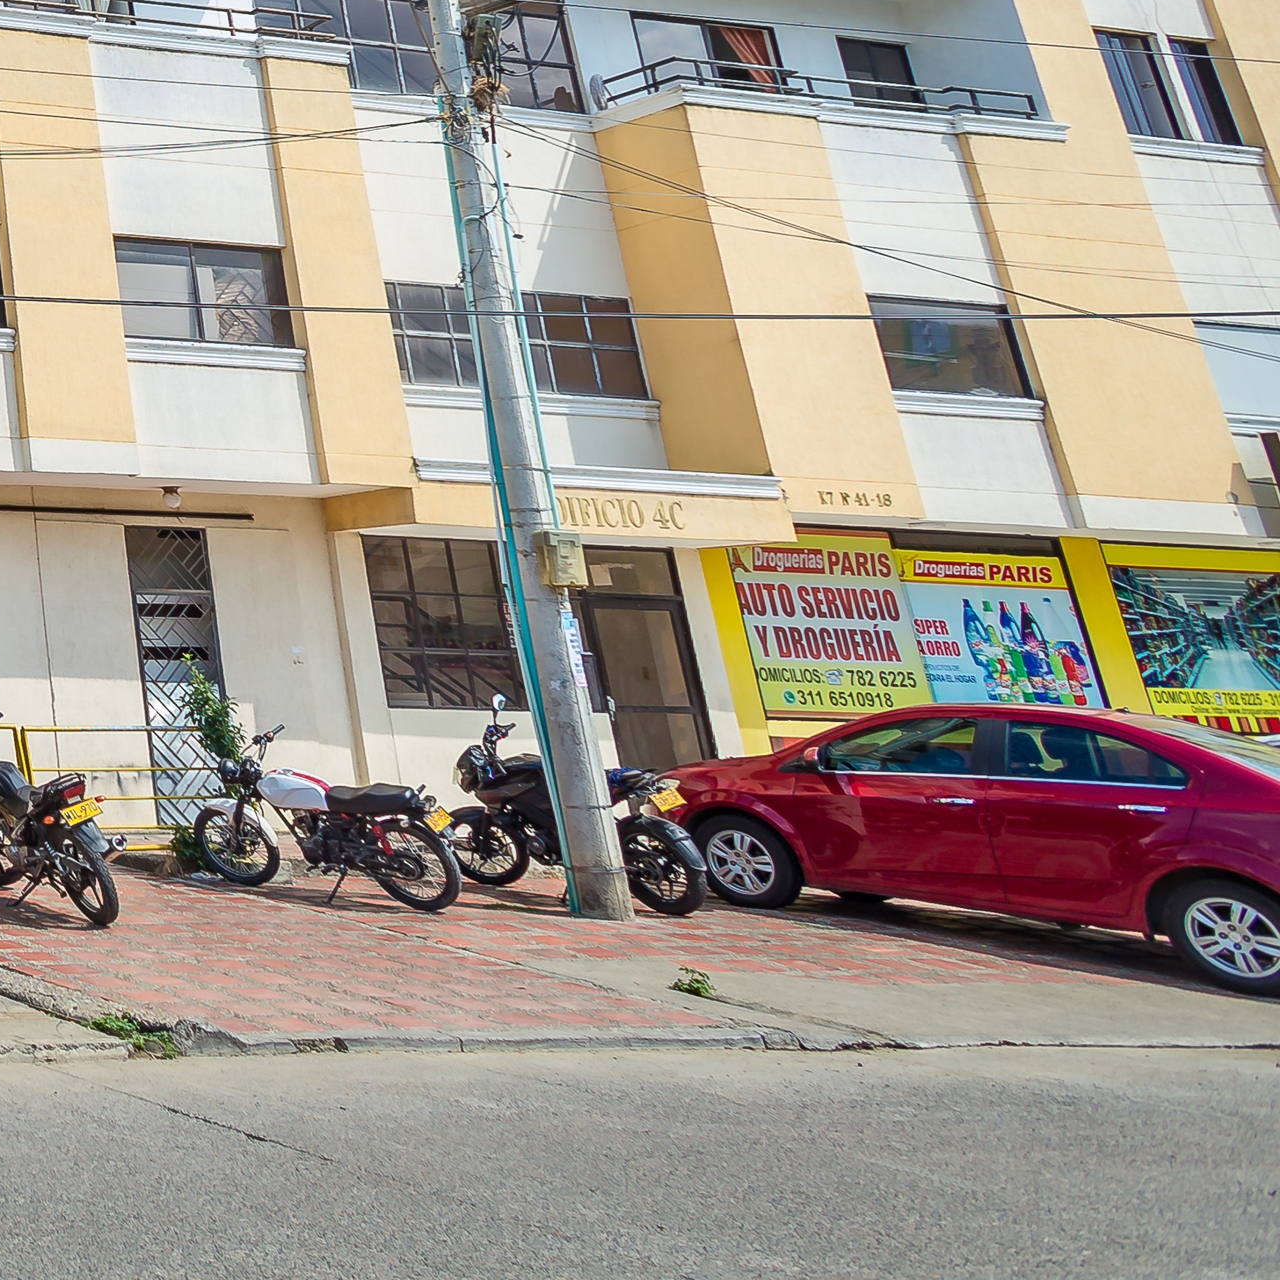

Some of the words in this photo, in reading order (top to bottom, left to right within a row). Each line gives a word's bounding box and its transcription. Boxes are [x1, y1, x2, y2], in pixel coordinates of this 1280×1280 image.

[854, 492, 892, 507] 41-18
[555, 496, 645, 528] DIFICIO
[754, 547, 824, 572] Droguerias
[827, 550, 892, 578] PARIS
[915, 560, 985, 577] Droguerias
[988, 564, 1053, 583] PARIS
[736, 582, 796, 617] AUTO
[797, 586, 901, 621] SERVICIO
[754, 625, 770, 658] Y
[772, 624, 902, 662] DROGUERÍA
[916, 640, 961, 657] AORRO
[757, 667, 825, 684] OMICILIOS:
[846, 670, 877, 687] 782
[879, 671, 917, 688] 6225
[797, 690, 824, 706] 311
[829, 691, 894, 708] 6510918
[1154, 690, 1214, 705] DOMICILIOS:
